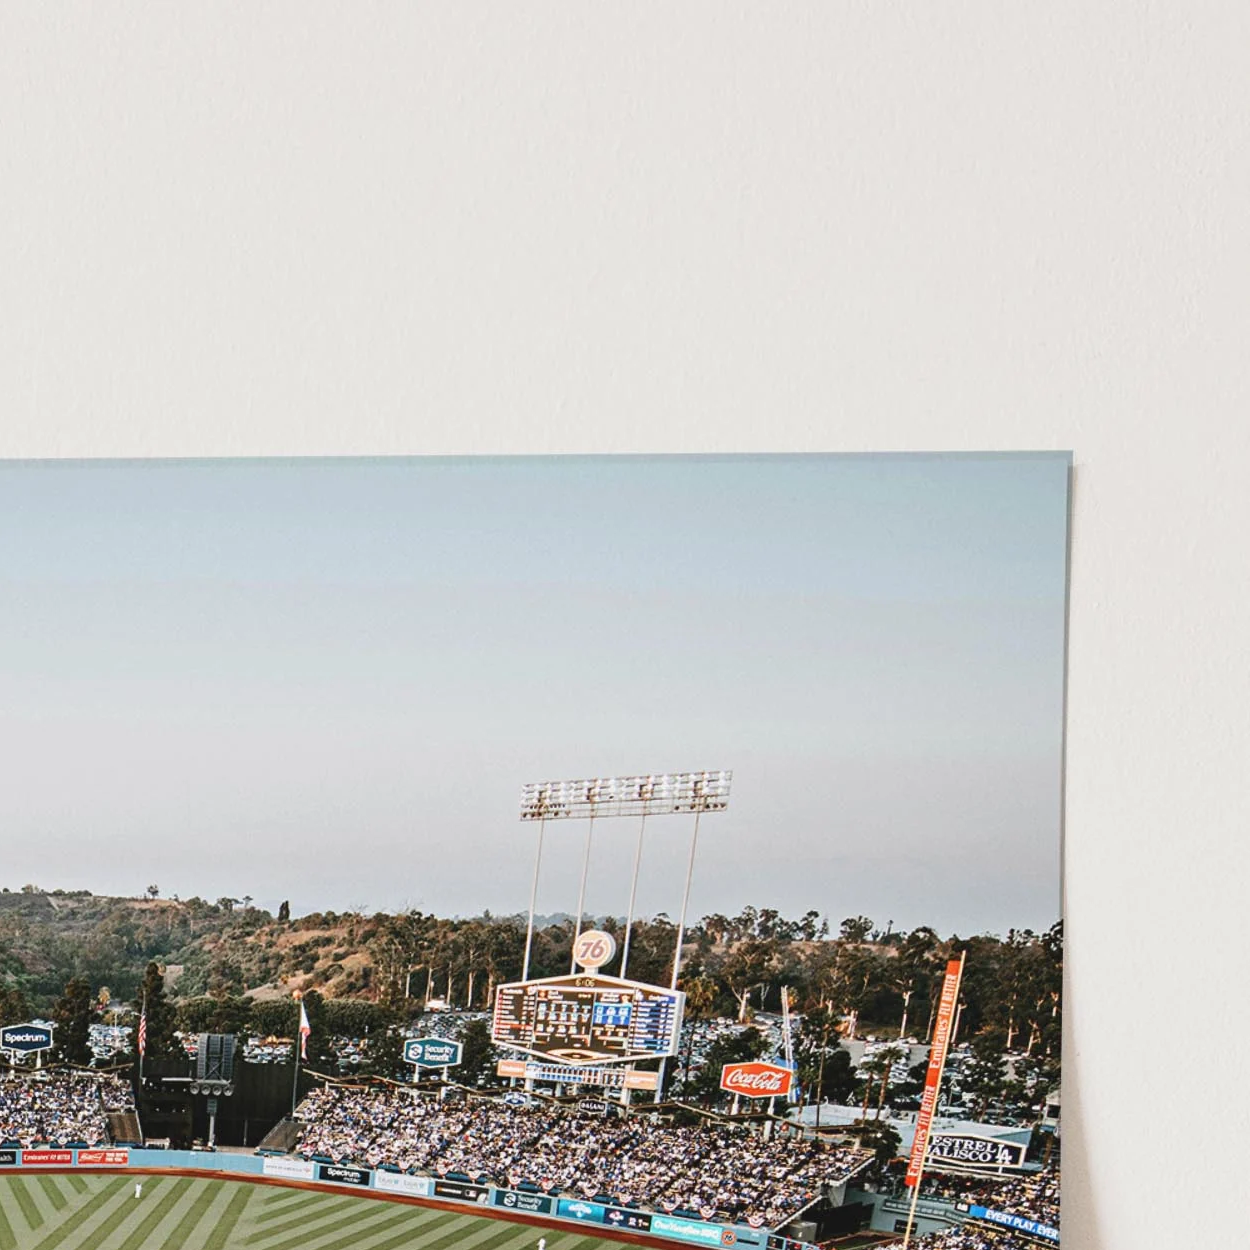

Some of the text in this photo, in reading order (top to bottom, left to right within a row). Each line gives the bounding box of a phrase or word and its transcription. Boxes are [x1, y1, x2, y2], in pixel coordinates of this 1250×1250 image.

[579, 939, 606, 959] 76
[930, 1017, 949, 1069] Emirates
[941, 974, 958, 1001] BETTER
[4, 1033, 46, 1044] Spectrum
[423, 1052, 451, 1063] Benefit
[424, 1044, 455, 1057] Security
[726, 1066, 782, 1090] Coca-Cola
[907, 1127, 927, 1177] Emirates
[920, 1085, 936, 1112] BETTER
[327, 1167, 360, 1179] Spectrum
[517, 1194, 543, 1206] Security
[985, 1209, 1012, 1226] EVERY
[1013, 1215, 1036, 1233] PLAY.
